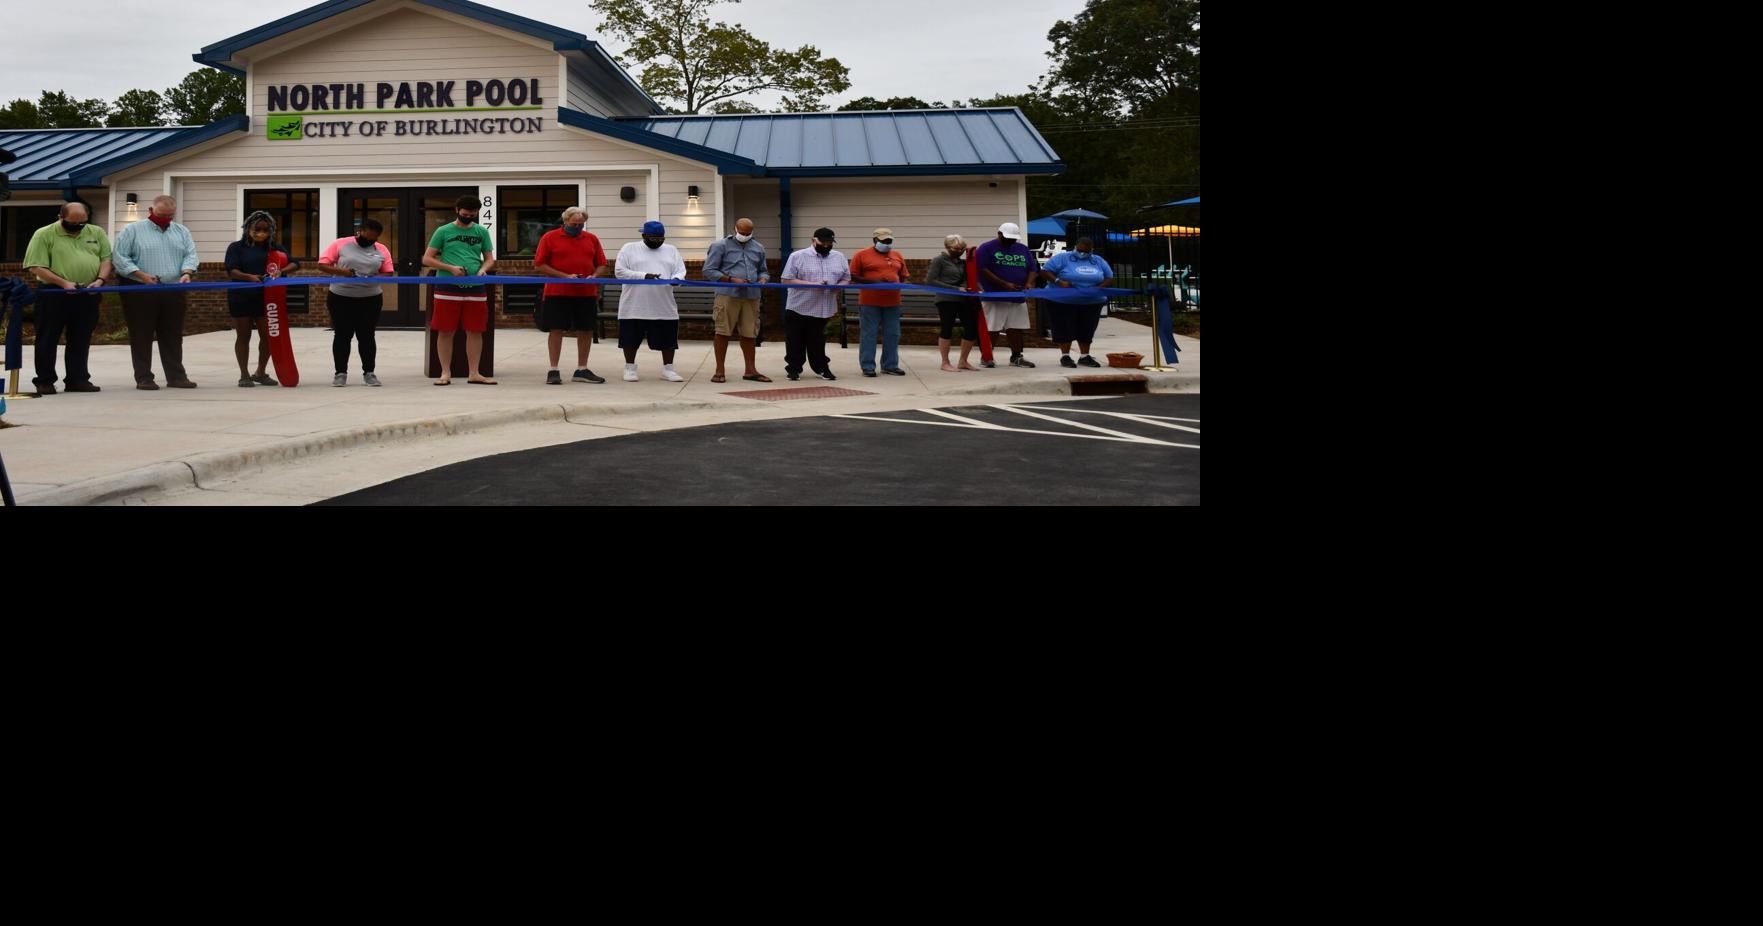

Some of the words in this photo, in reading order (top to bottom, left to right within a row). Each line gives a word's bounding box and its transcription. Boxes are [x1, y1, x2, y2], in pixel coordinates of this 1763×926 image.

[267, 84, 365, 112] NORTH
[376, 81, 456, 109] PARK
[466, 78, 544, 107] POOL
[303, 121, 353, 138] CITY
[359, 121, 388, 137] OF
[394, 117, 543, 136] BURLINGTON
[994, 251, 1025, 261] COPS
[266, 302, 280, 338] GUARD
